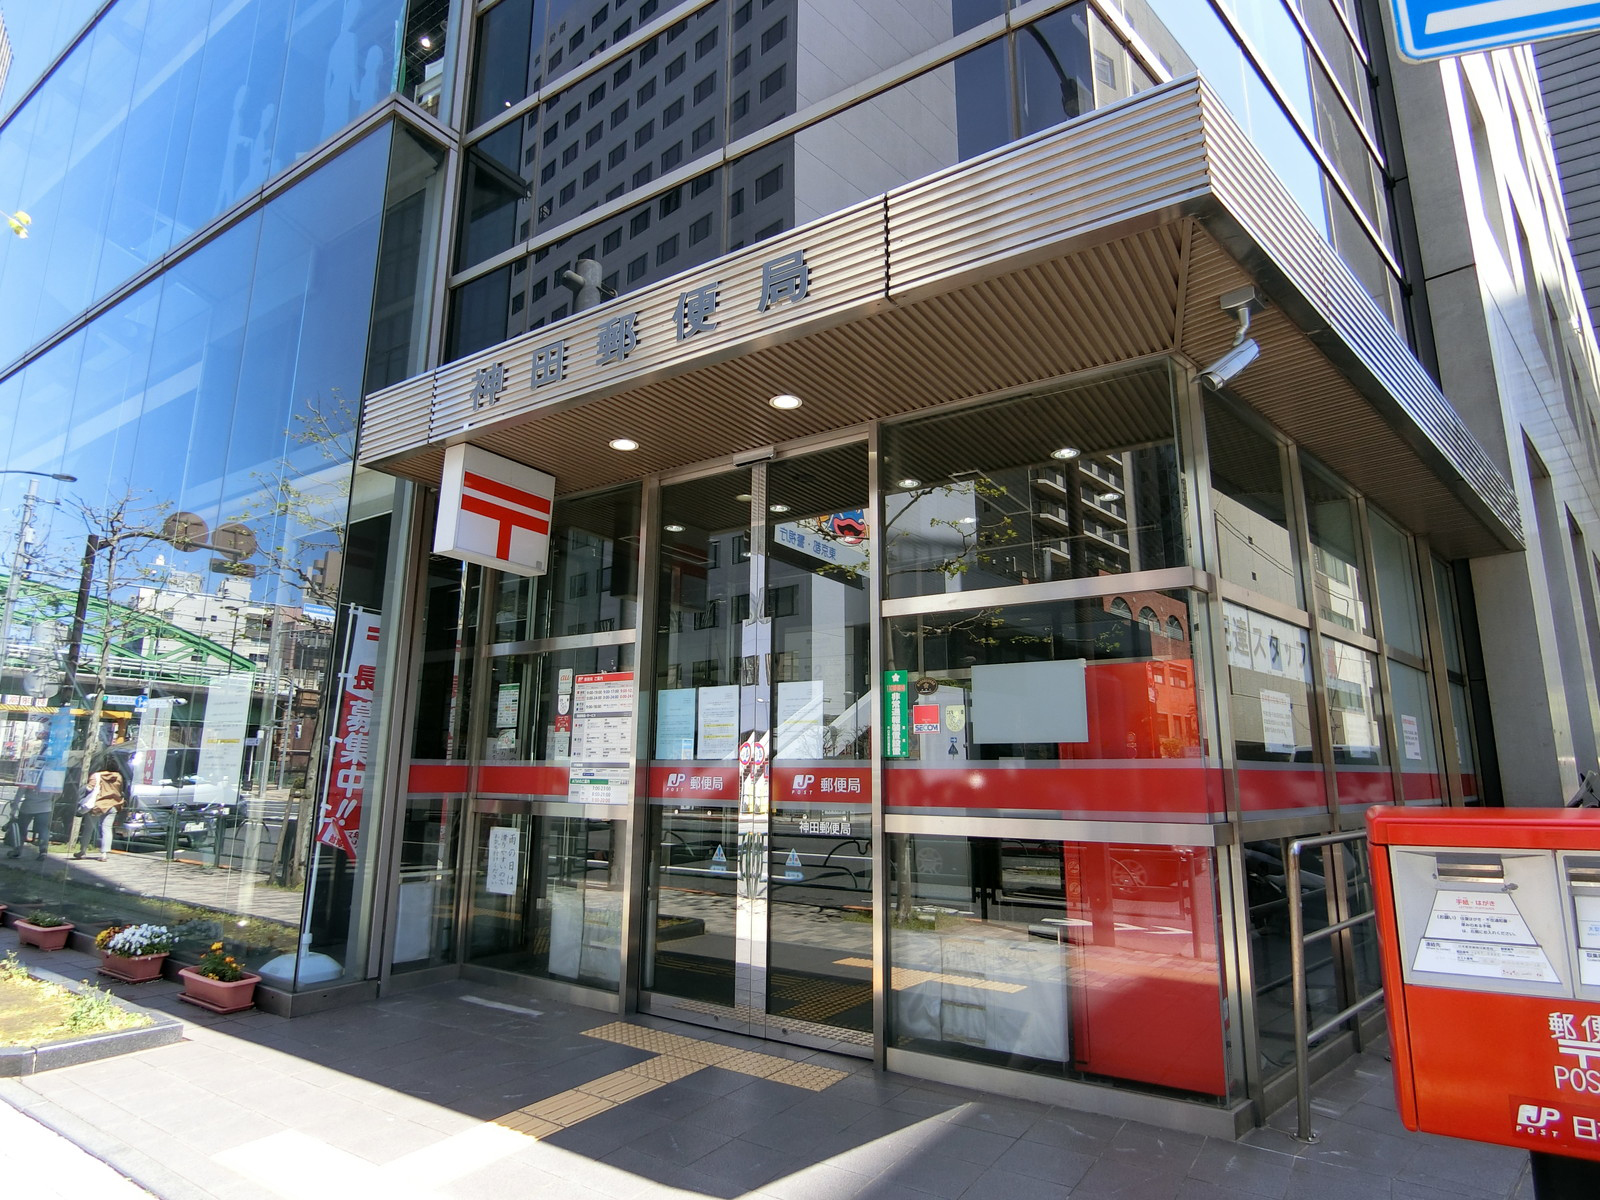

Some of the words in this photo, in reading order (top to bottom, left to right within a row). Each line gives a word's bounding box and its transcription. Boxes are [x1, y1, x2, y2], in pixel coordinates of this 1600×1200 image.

[469, 248, 809, 411] 神田郵便局
[914, 724, 938, 732] SECOM
[690, 776, 723, 791] 郵便局
[820, 777, 861, 794] 郵便局
[799, 820, 851, 836] 神田郵便局
[1456, 898, 1495, 907] 手紙・はがき
[1517, 1104, 1560, 1127] JP
[1572, 1116, 1600, 1140] 日
[1516, 1125, 1558, 1138] POST
